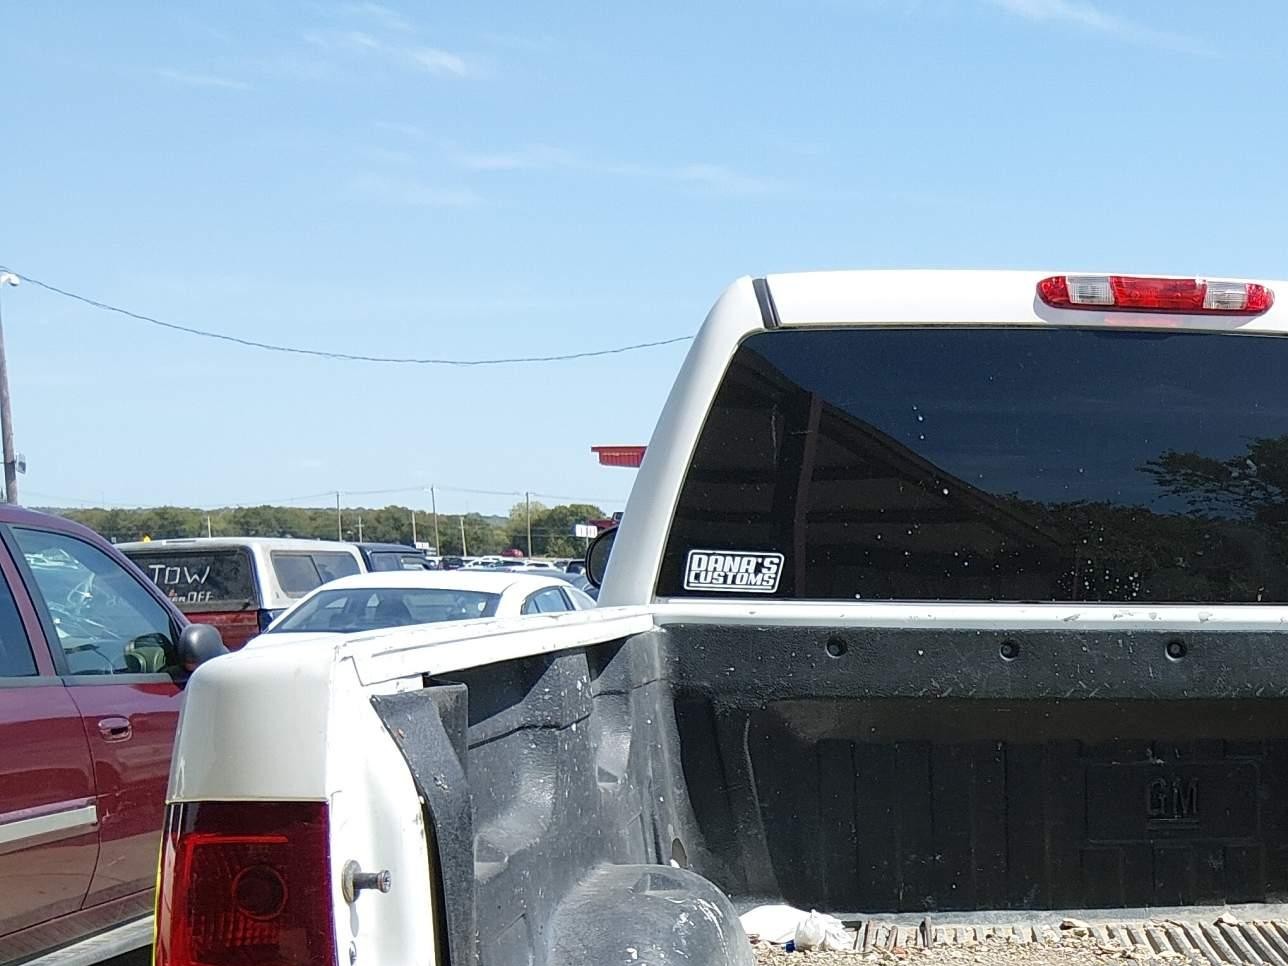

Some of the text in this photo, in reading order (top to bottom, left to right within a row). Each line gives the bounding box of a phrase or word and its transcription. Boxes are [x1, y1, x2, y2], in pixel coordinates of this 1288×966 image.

[690, 554, 780, 574] DANA'S
[148, 564, 211, 585] TOW
[688, 570, 776, 586] CUSTOMS
[1147, 776, 1200, 817] GM
